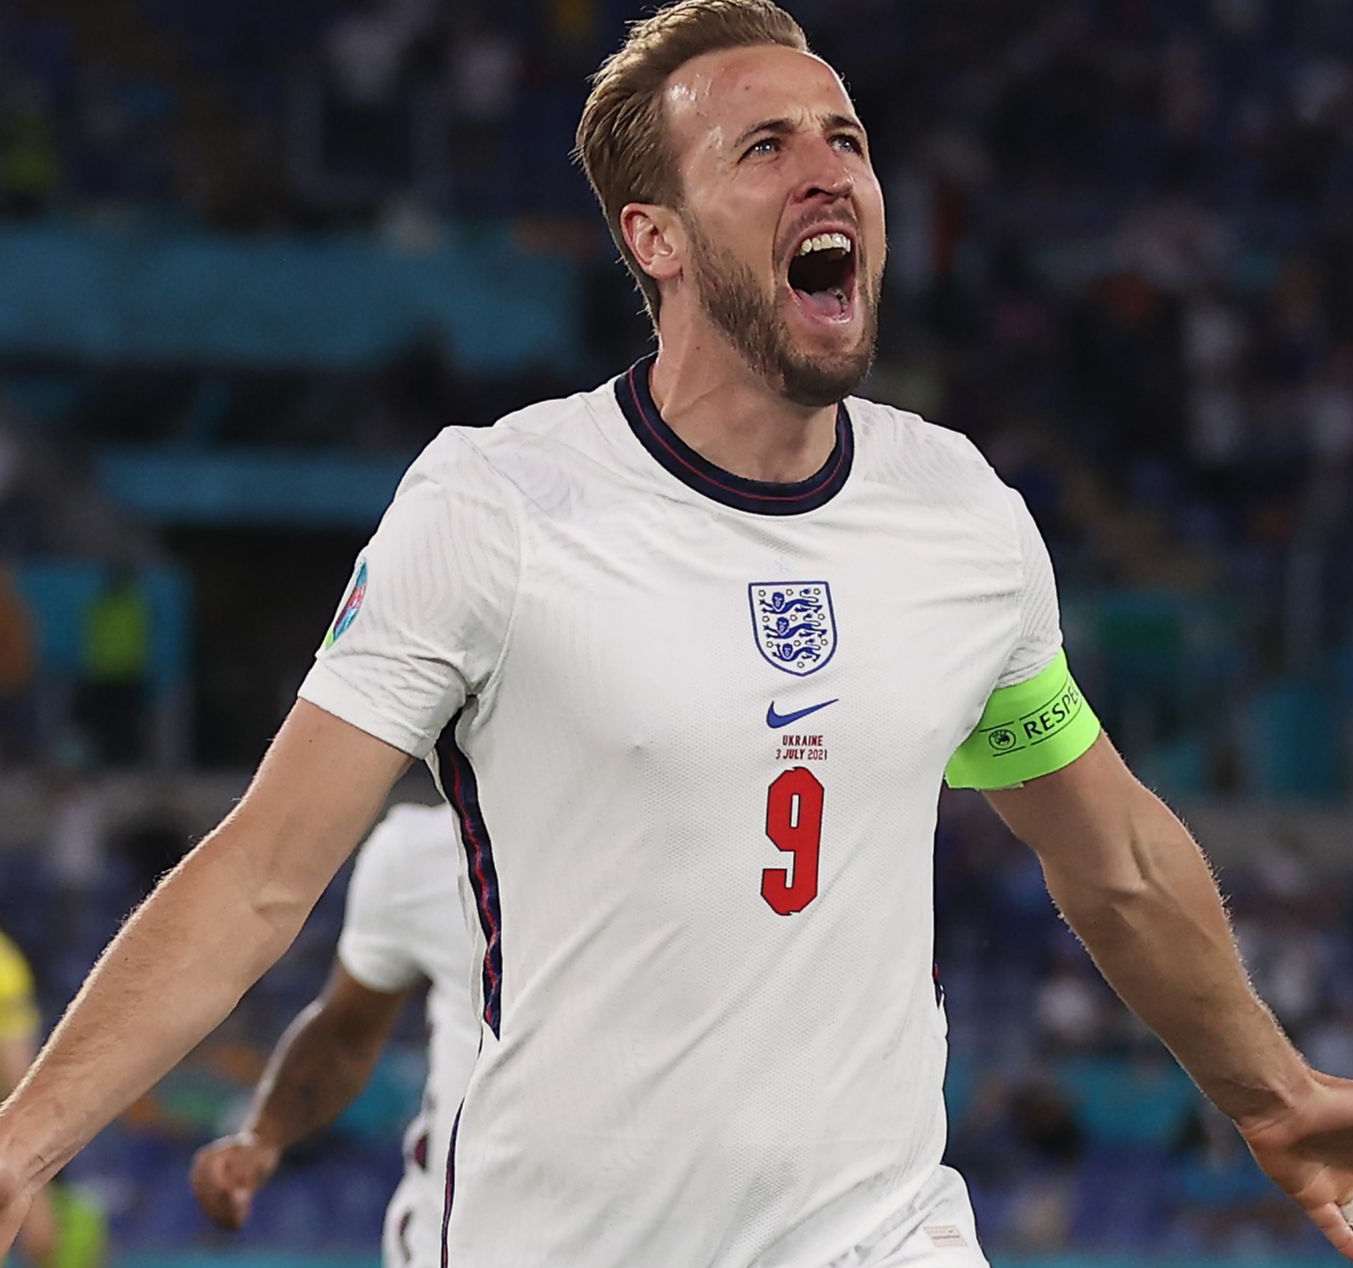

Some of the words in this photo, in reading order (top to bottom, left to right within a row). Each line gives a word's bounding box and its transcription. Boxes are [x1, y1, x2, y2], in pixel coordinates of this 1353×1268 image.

[782, 735, 824, 747] UKRAINE
[775, 748, 782, 760] 3
[782, 748, 806, 760] JULY
[807, 748, 828, 760] 2021
[760, 766, 825, 916] 9
